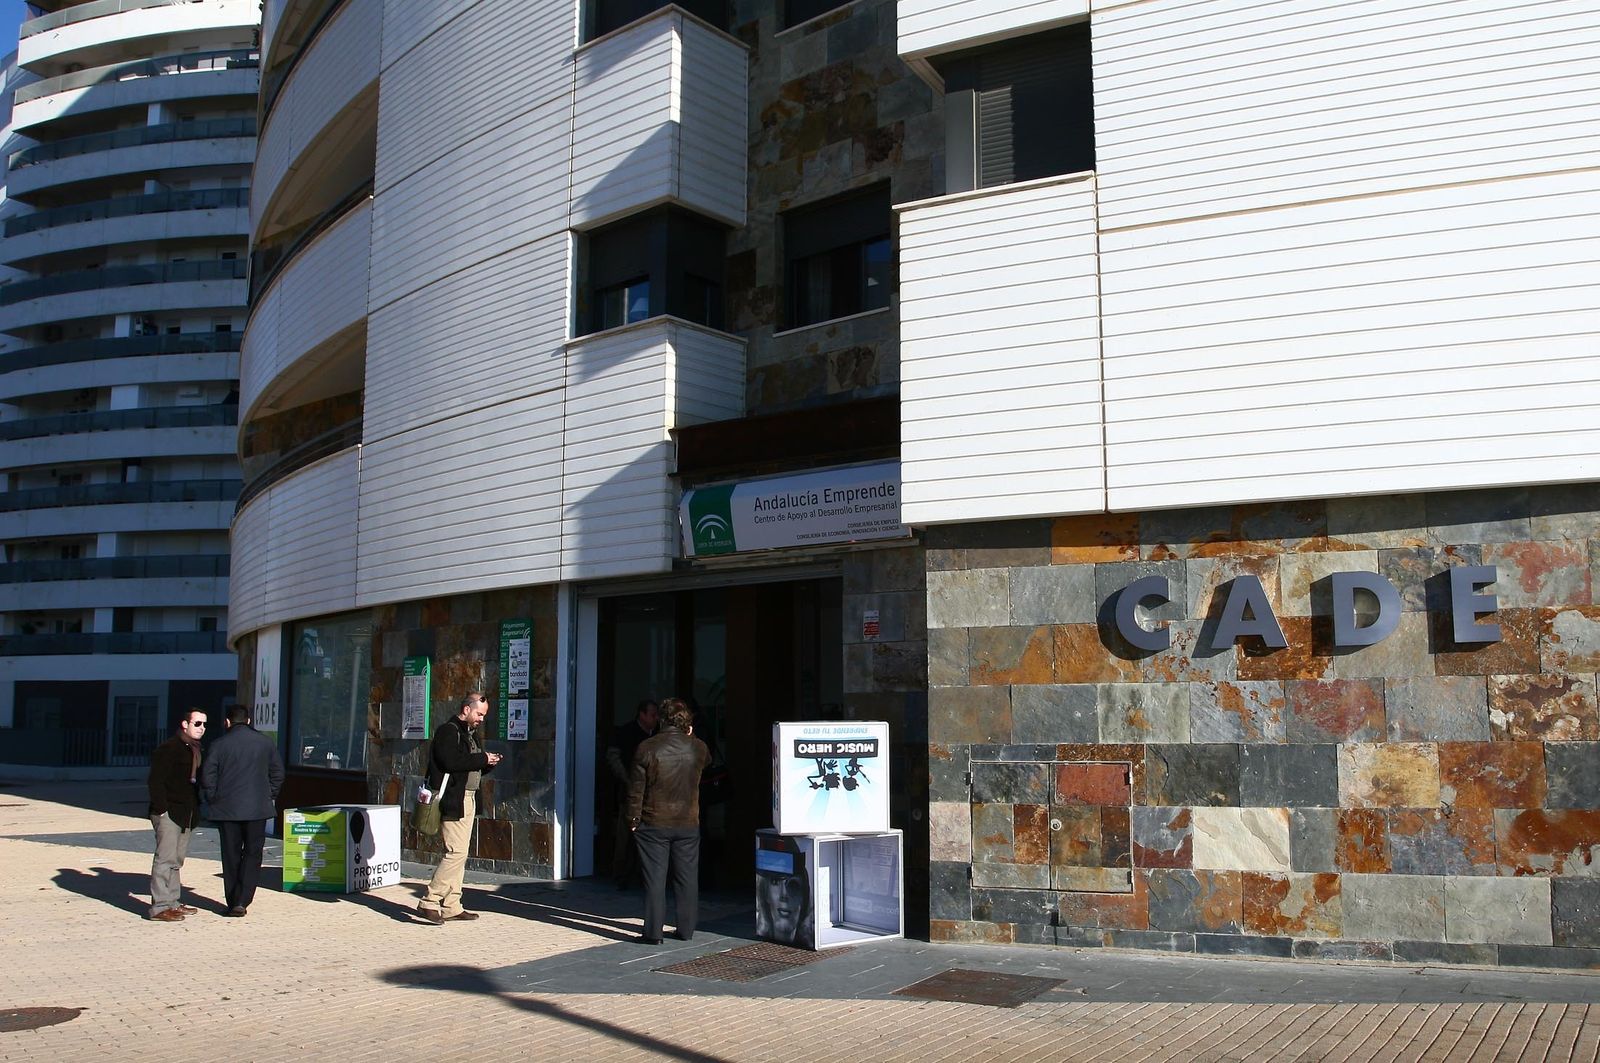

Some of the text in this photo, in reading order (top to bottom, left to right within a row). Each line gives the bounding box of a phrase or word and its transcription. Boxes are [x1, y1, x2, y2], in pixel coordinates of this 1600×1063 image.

[754, 482, 895, 511] Andalucía Emprende
[754, 501, 898, 524] Centro de Apoyo al Desarrollo Empresarial
[1115, 565, 1501, 651] CADE
[255, 702, 276, 725] CADE
[797, 743, 874, 754] MUSIC HERO
[353, 861, 400, 878] PROYECTO
[353, 876, 383, 890] LUNAR
